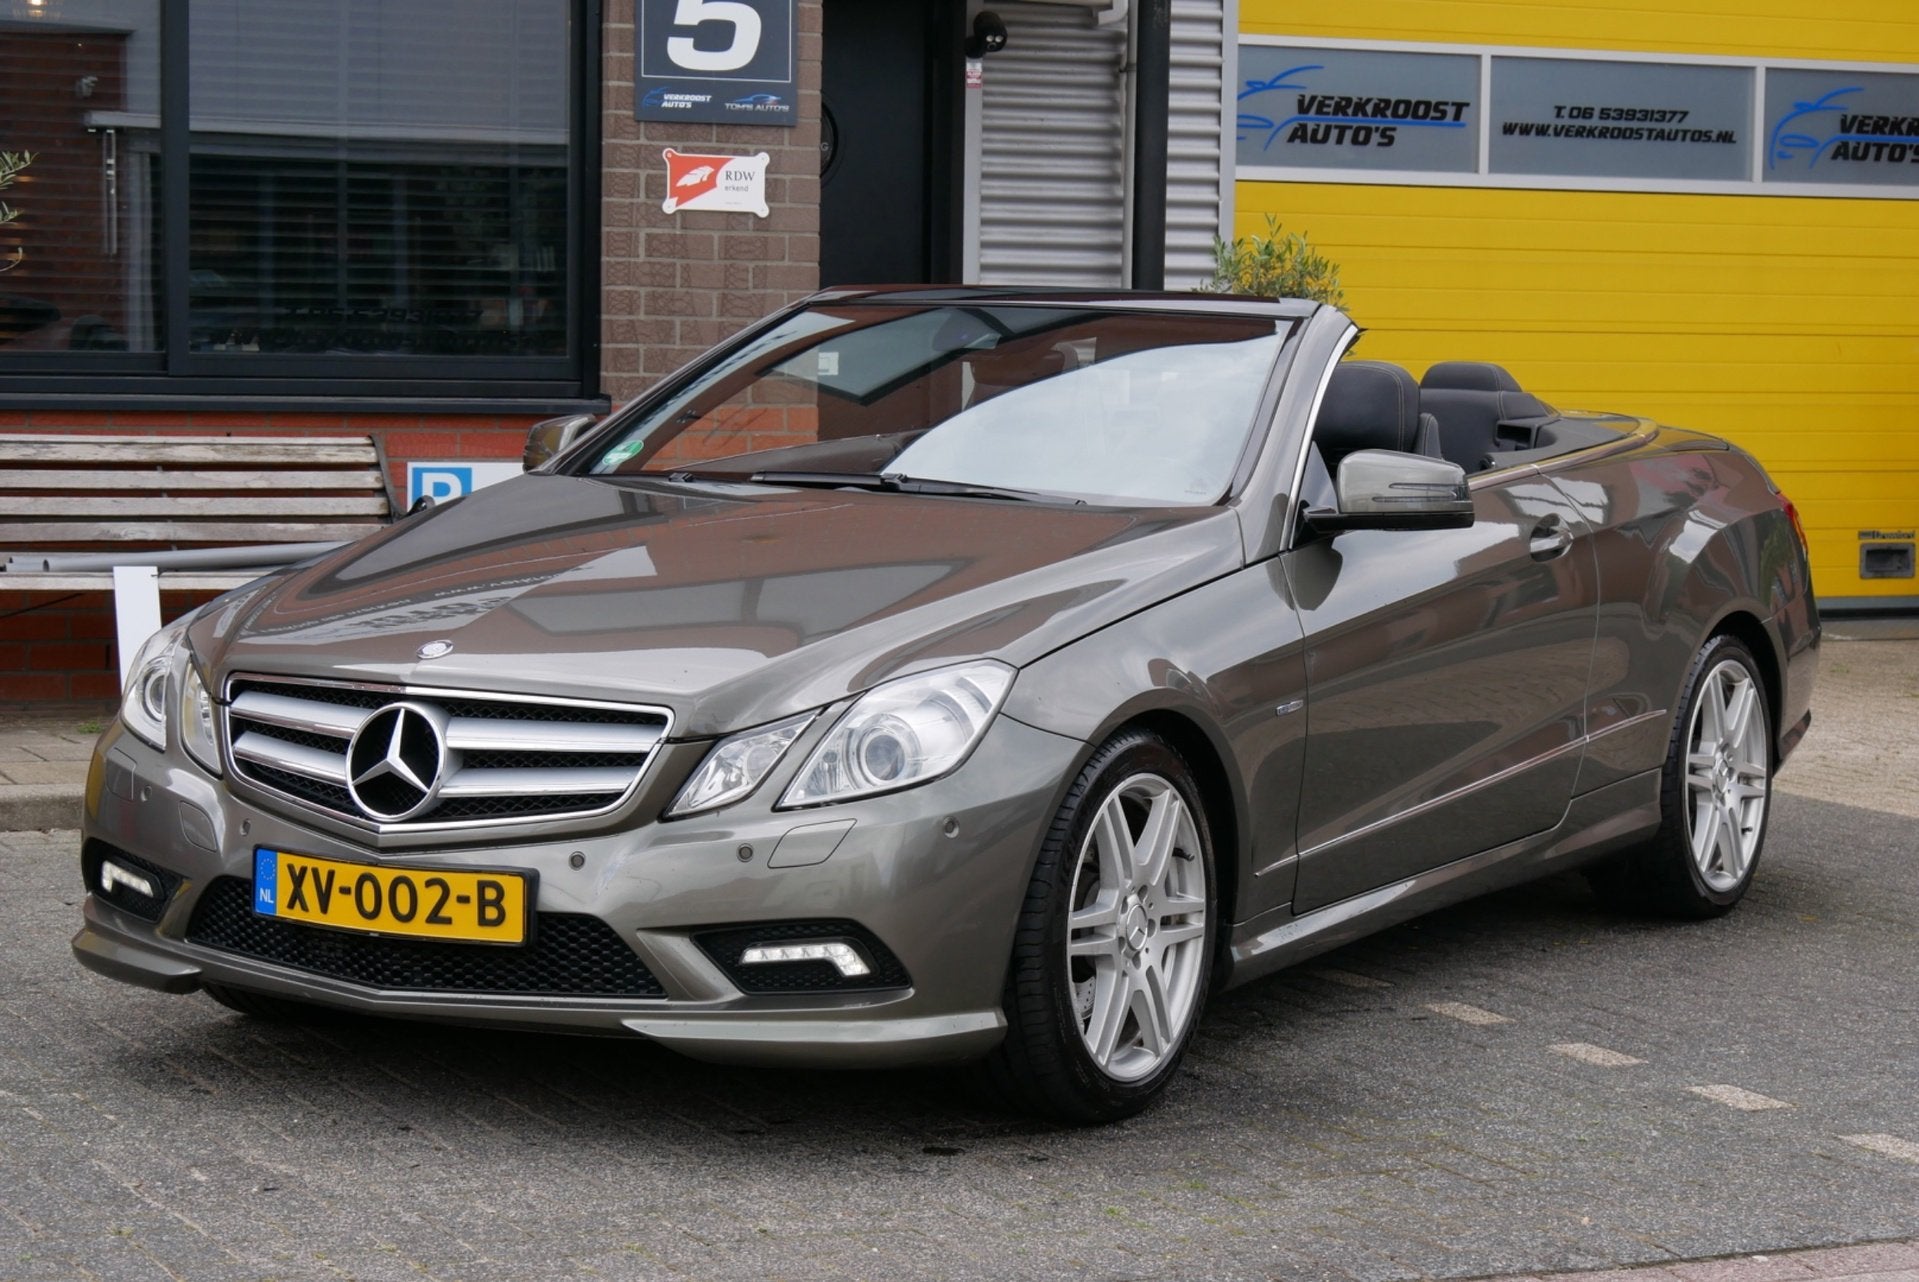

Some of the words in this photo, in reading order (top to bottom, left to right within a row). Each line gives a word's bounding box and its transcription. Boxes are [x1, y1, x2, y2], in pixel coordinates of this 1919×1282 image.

[667, 0, 762, 71] 5
[663, 93, 712, 102] VERKROOST
[1297, 94, 1470, 121] VERKROOST
[1569, 106, 1594, 119] 06
[1598, 108, 1689, 123] 53931377
[1287, 122, 1397, 147] AUTO'S
[1502, 121, 1737, 144] WWW.VERKROOSTAUTOS.NL
[725, 170, 755, 181] RDW
[259, 888, 274, 904] NL
[286, 863, 506, 927] XV-002-B
